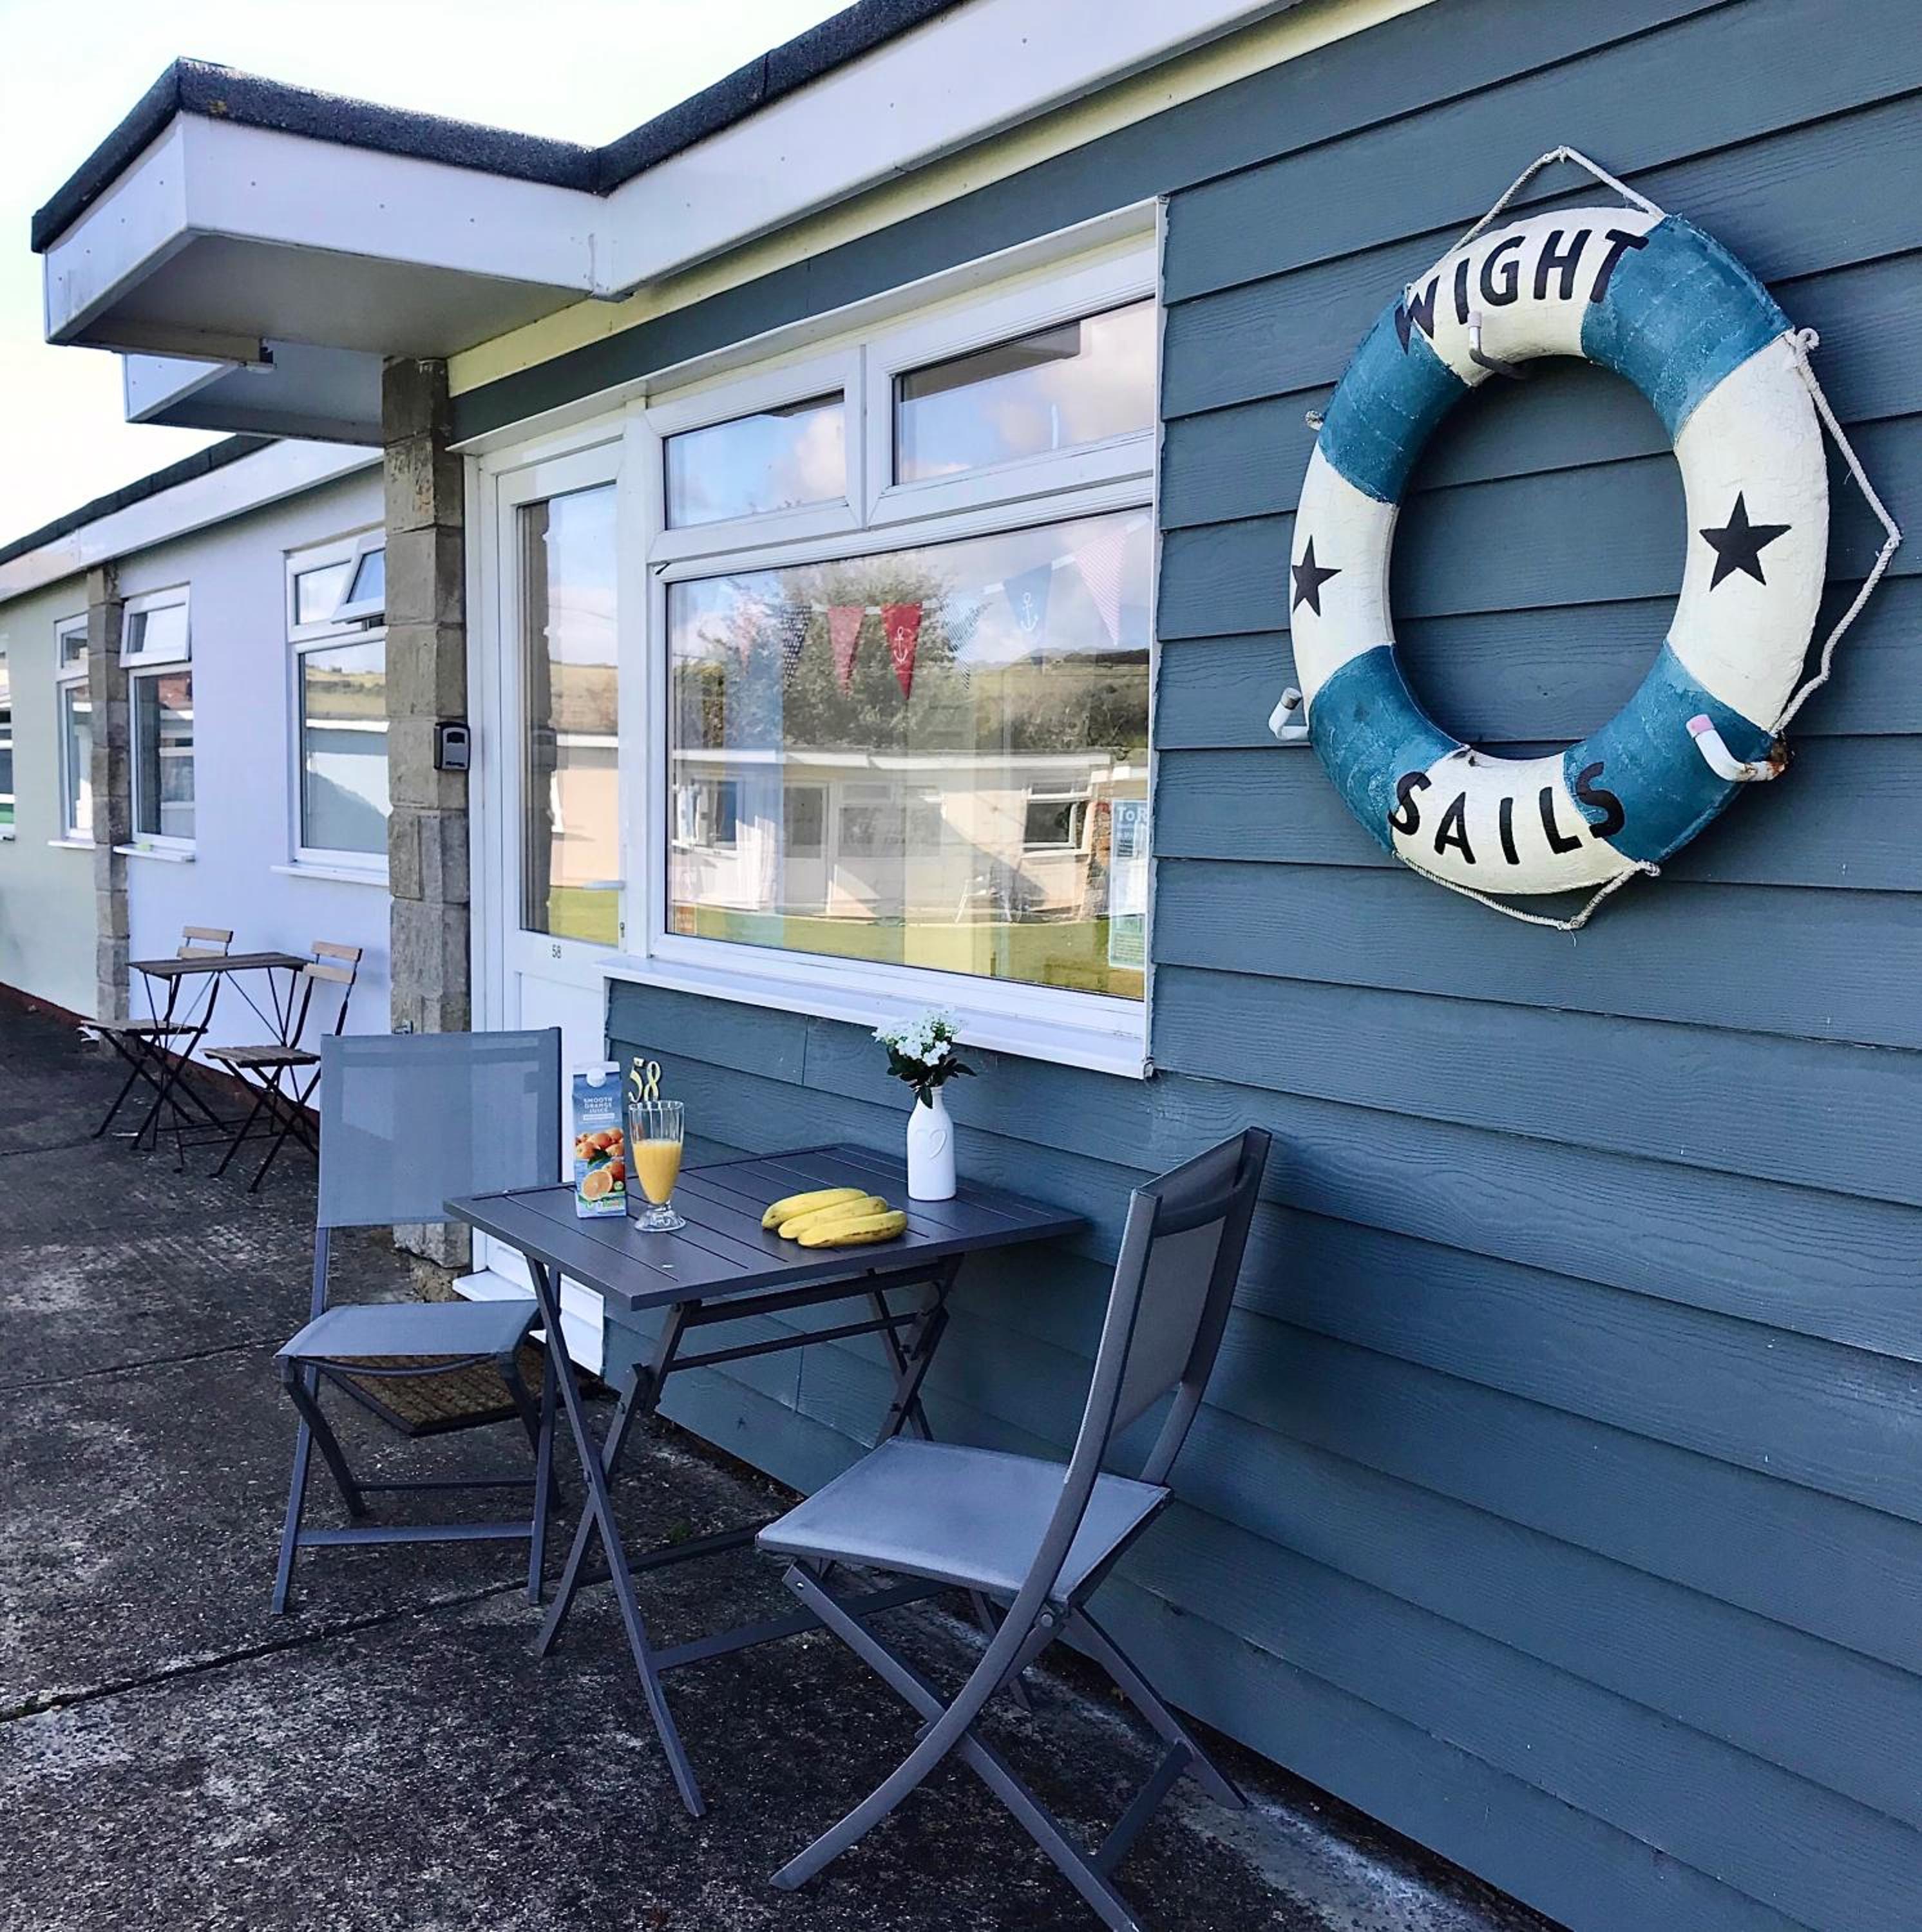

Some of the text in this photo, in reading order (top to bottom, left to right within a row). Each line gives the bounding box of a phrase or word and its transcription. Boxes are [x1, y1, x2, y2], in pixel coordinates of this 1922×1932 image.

[1394, 229, 1649, 355] WIGHT
[1387, 761, 1625, 865] SAILS
[552, 944, 561, 959] 58
[628, 1057, 661, 1103] 58
